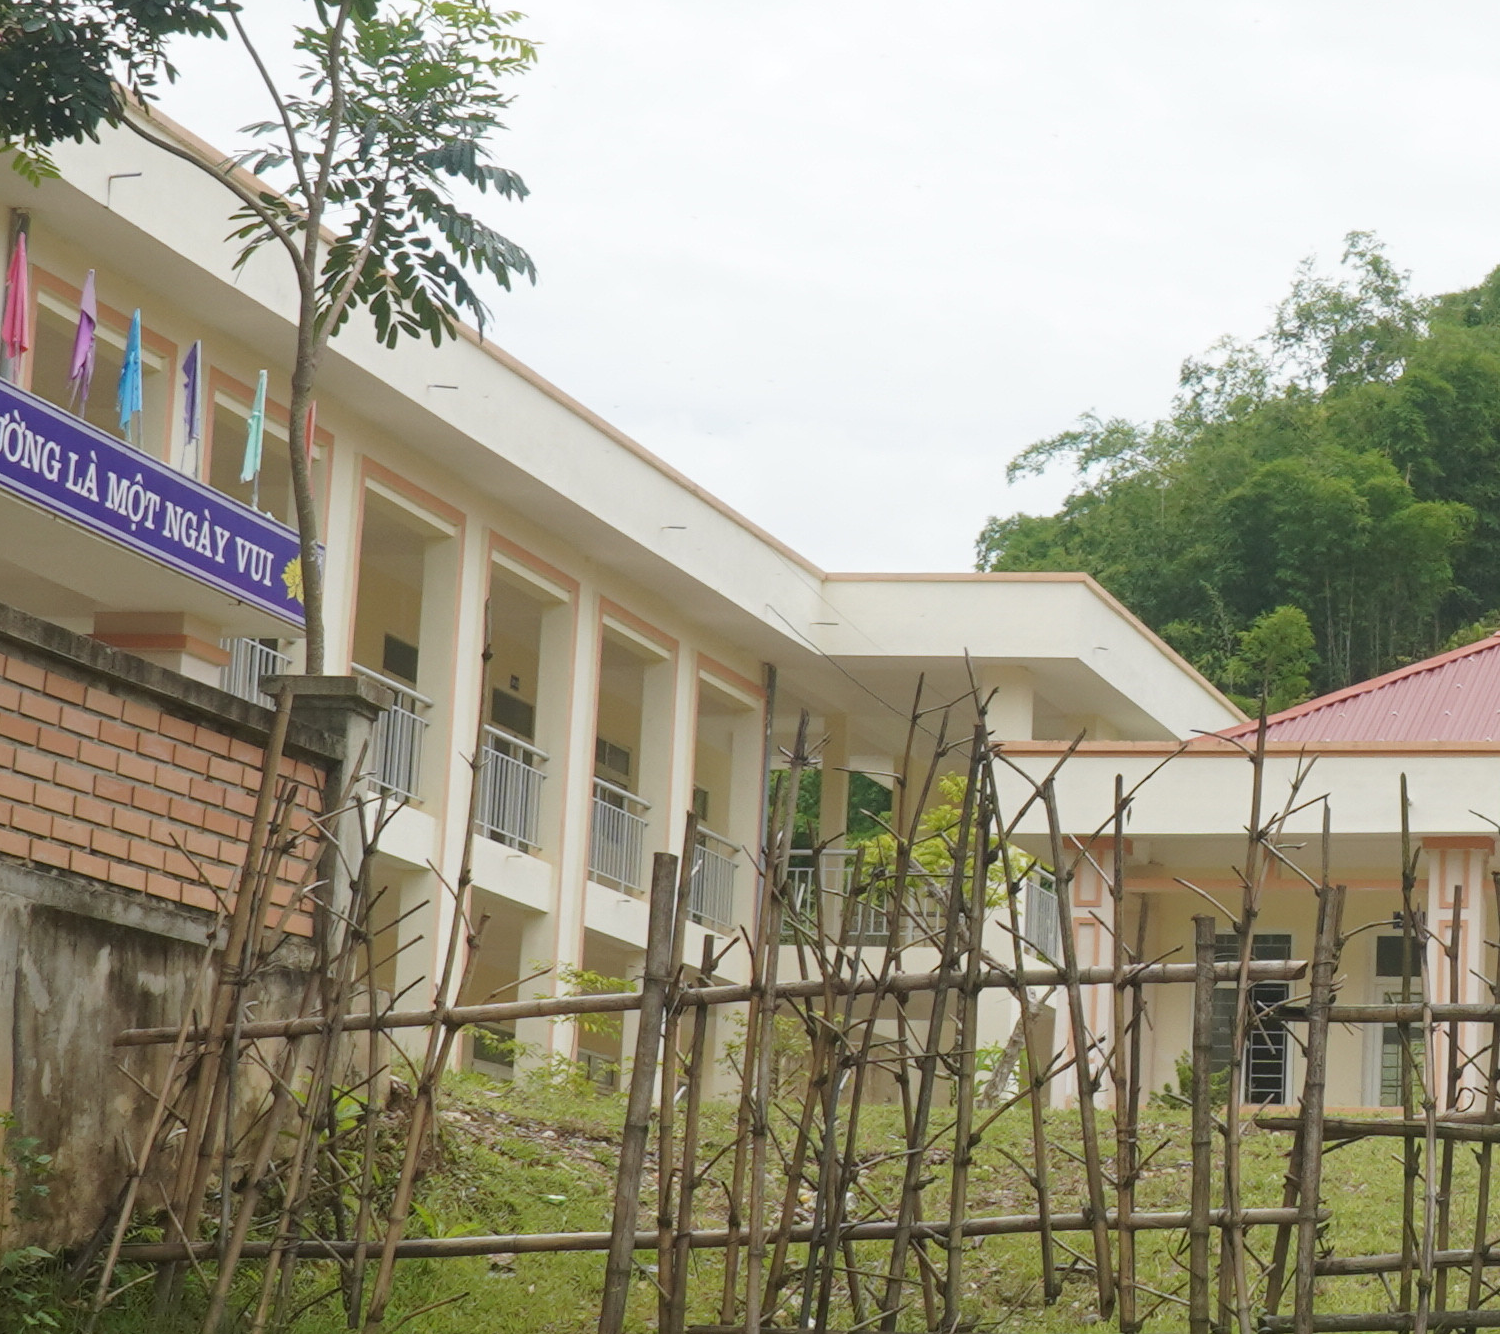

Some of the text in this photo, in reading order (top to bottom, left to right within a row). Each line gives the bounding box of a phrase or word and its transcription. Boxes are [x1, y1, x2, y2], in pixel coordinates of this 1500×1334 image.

[65, 450, 100, 503] LÀ
[105, 473, 161, 531] MỘT
[162, 500, 231, 564] NGÀY
[235, 536, 274, 587] VUI
